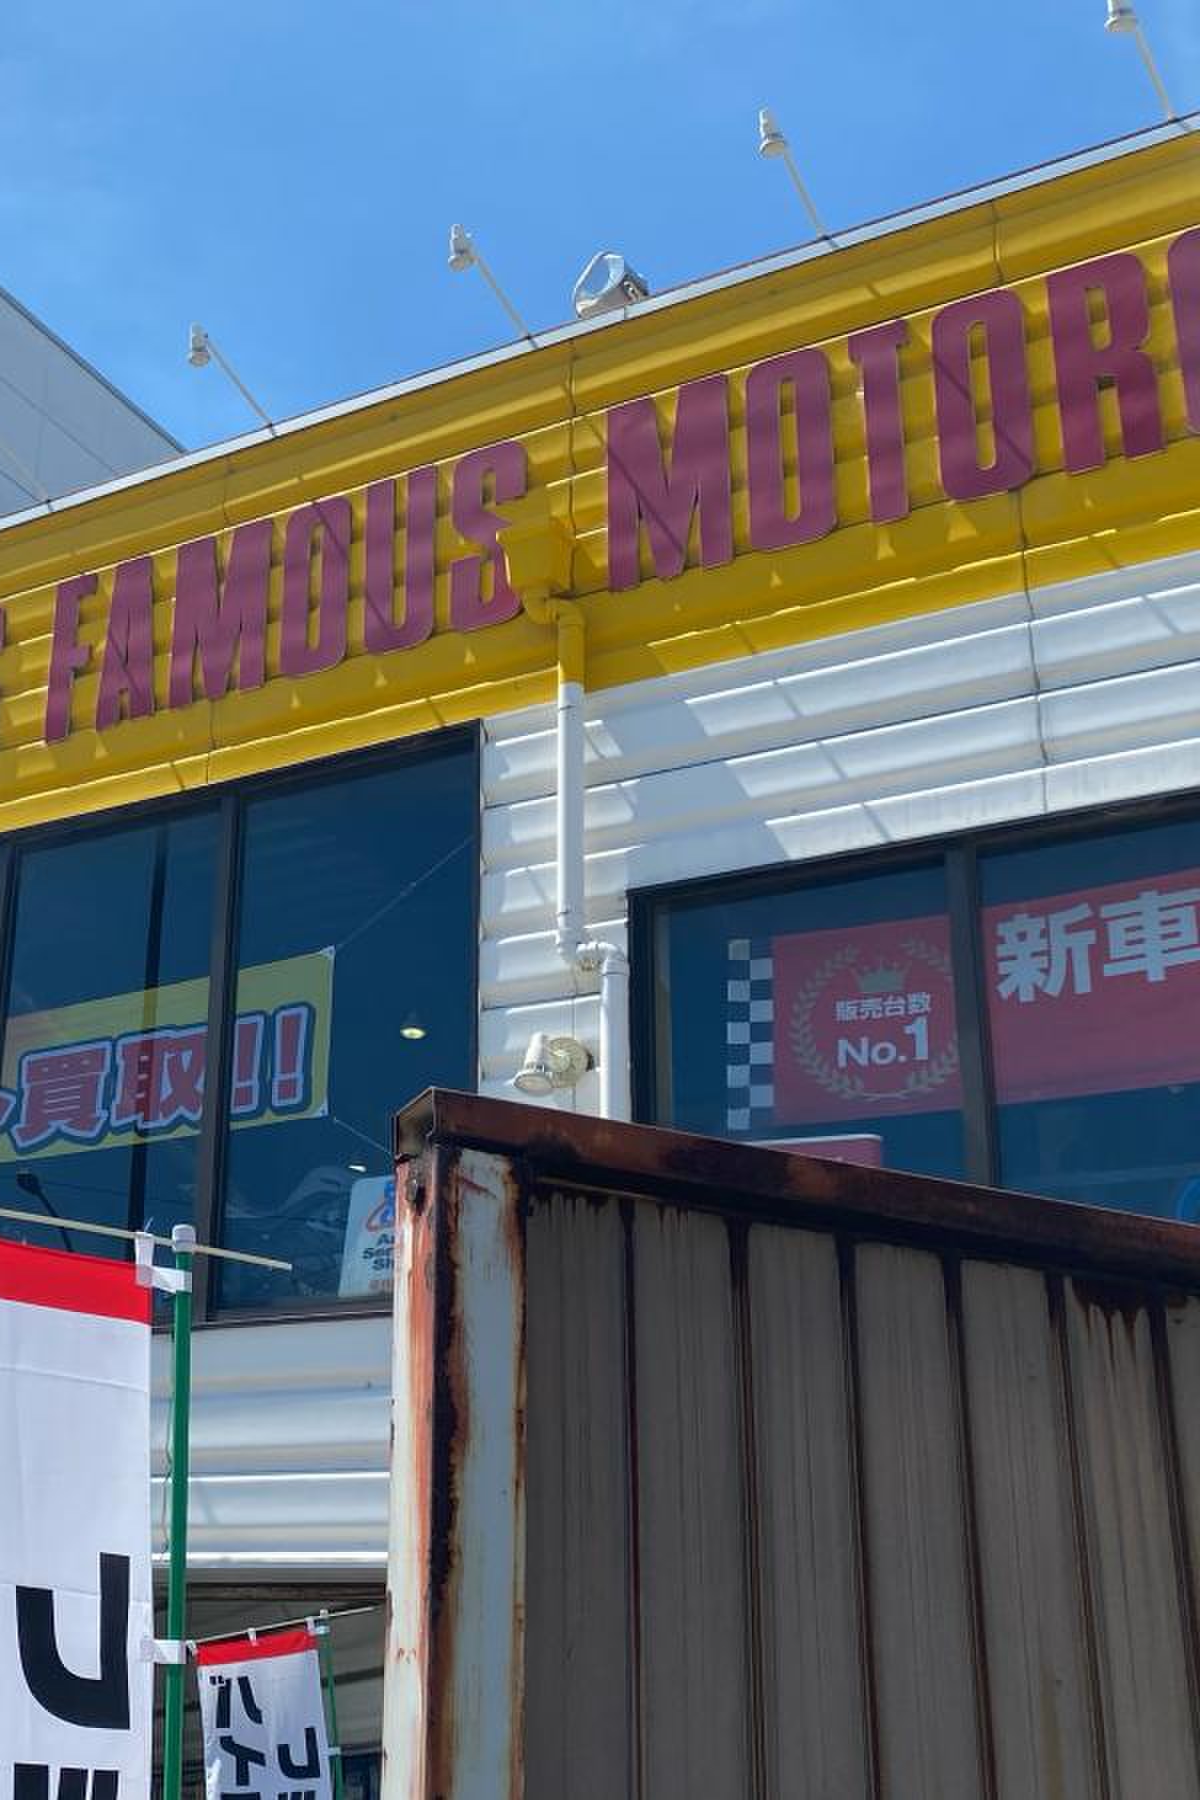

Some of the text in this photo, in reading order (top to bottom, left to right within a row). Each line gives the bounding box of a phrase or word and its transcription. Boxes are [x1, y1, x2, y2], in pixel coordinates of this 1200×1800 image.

[44, 440, 529, 744] FAMOUS
[995, 887, 1200, 1004] 新車
[835, 991, 932, 1022] 販売台数
[837, 1016, 929, 1069] No.1
